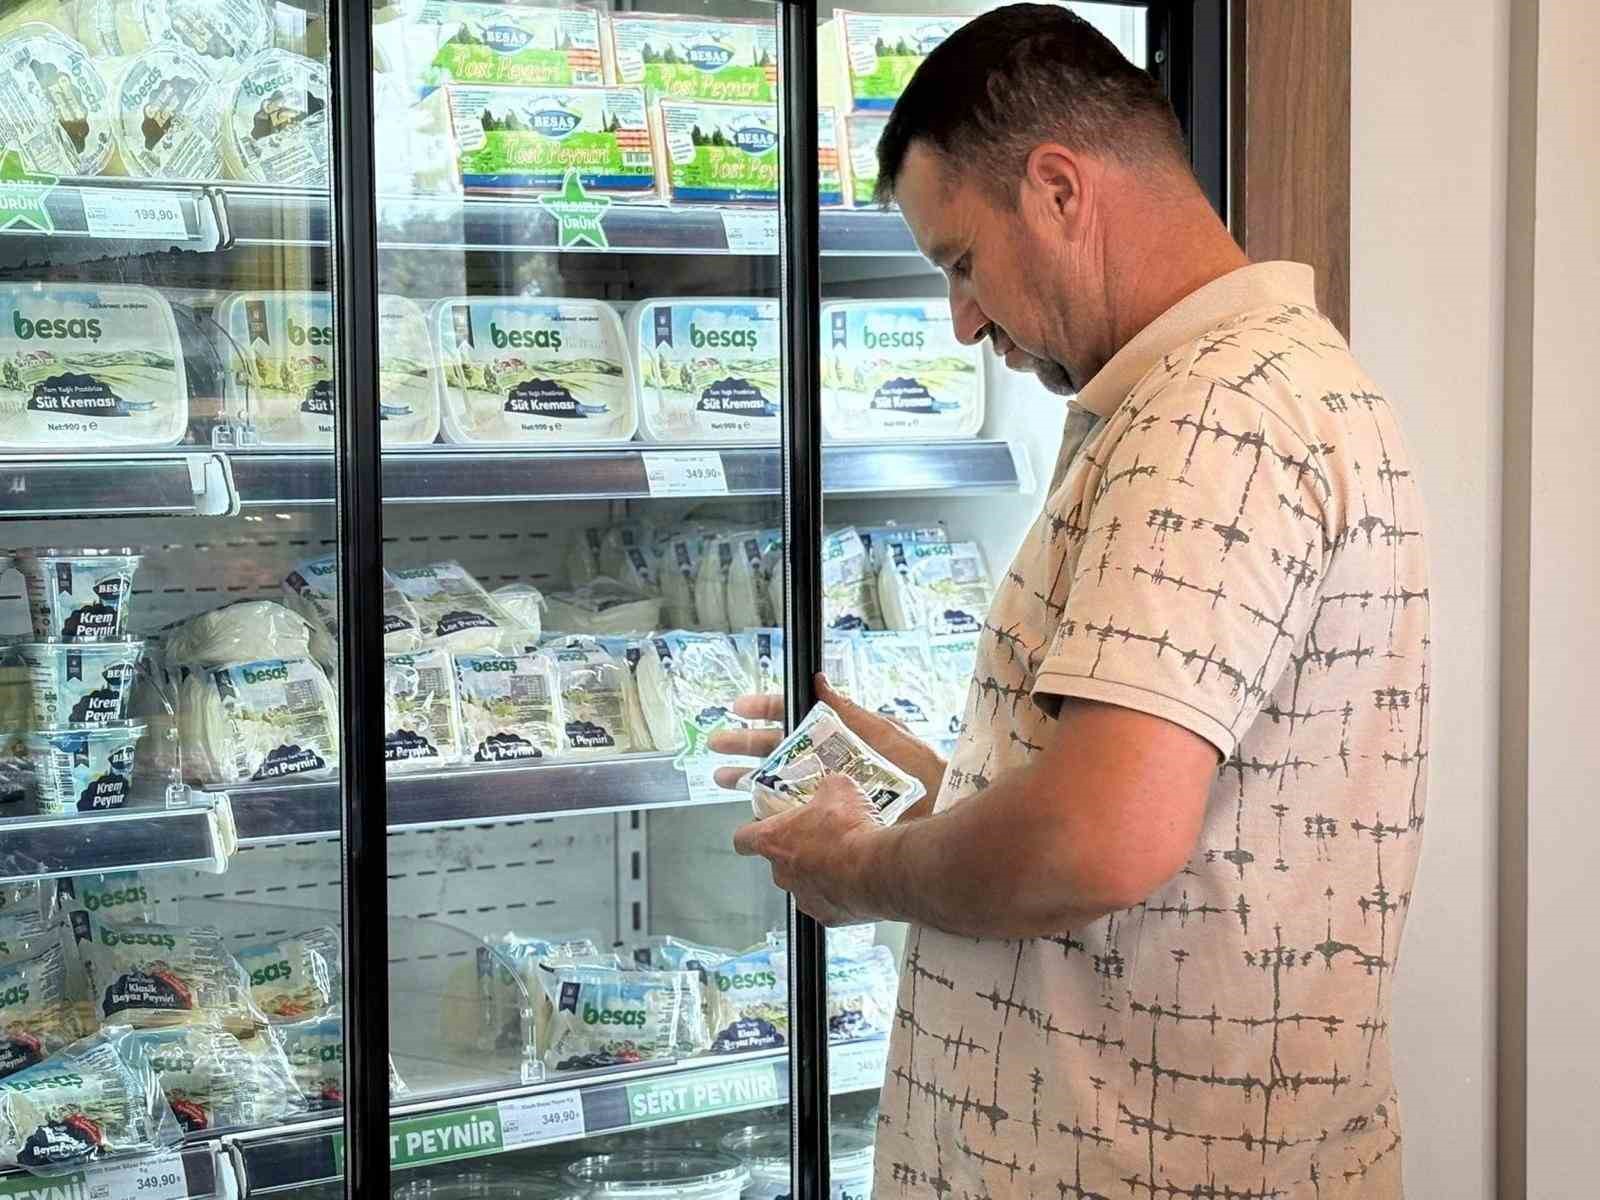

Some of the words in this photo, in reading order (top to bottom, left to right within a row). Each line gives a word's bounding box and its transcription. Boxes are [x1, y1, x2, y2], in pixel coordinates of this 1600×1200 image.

[13, 310, 102, 344] besaş
[490, 322, 562, 352] besaş
[689, 322, 758, 352] besaş
[863, 325, 925, 352] besaş
[35, 396, 59, 409] Süt
[60, 395, 116, 409] Kreması
[308, 398, 328, 411] Süt
[510, 400, 529, 411] Süt
[530, 399, 575, 411] Kreması
[703, 398, 721, 410] Süt
[722, 397, 765, 410] Kreması
[79, 611, 113, 624] Krem
[76, 624, 116, 639] Peynir
[242, 666, 289, 685] besaş
[280, 755, 318, 774] Peyniri
[96, 781, 124, 795] Krem
[92, 794, 125, 809] Peynir
[83, 886, 148, 912] besaş
[99, 925, 176, 951] besaş
[715, 970, 777, 992] besaş
[583, 1002, 647, 1030] besaş
[632, 1086, 688, 1118] SERT
[542, 1109, 575, 1125] 349,90
[406, 1114, 497, 1157] PEYNİR
[136, 1172, 176, 1190] 349,90
